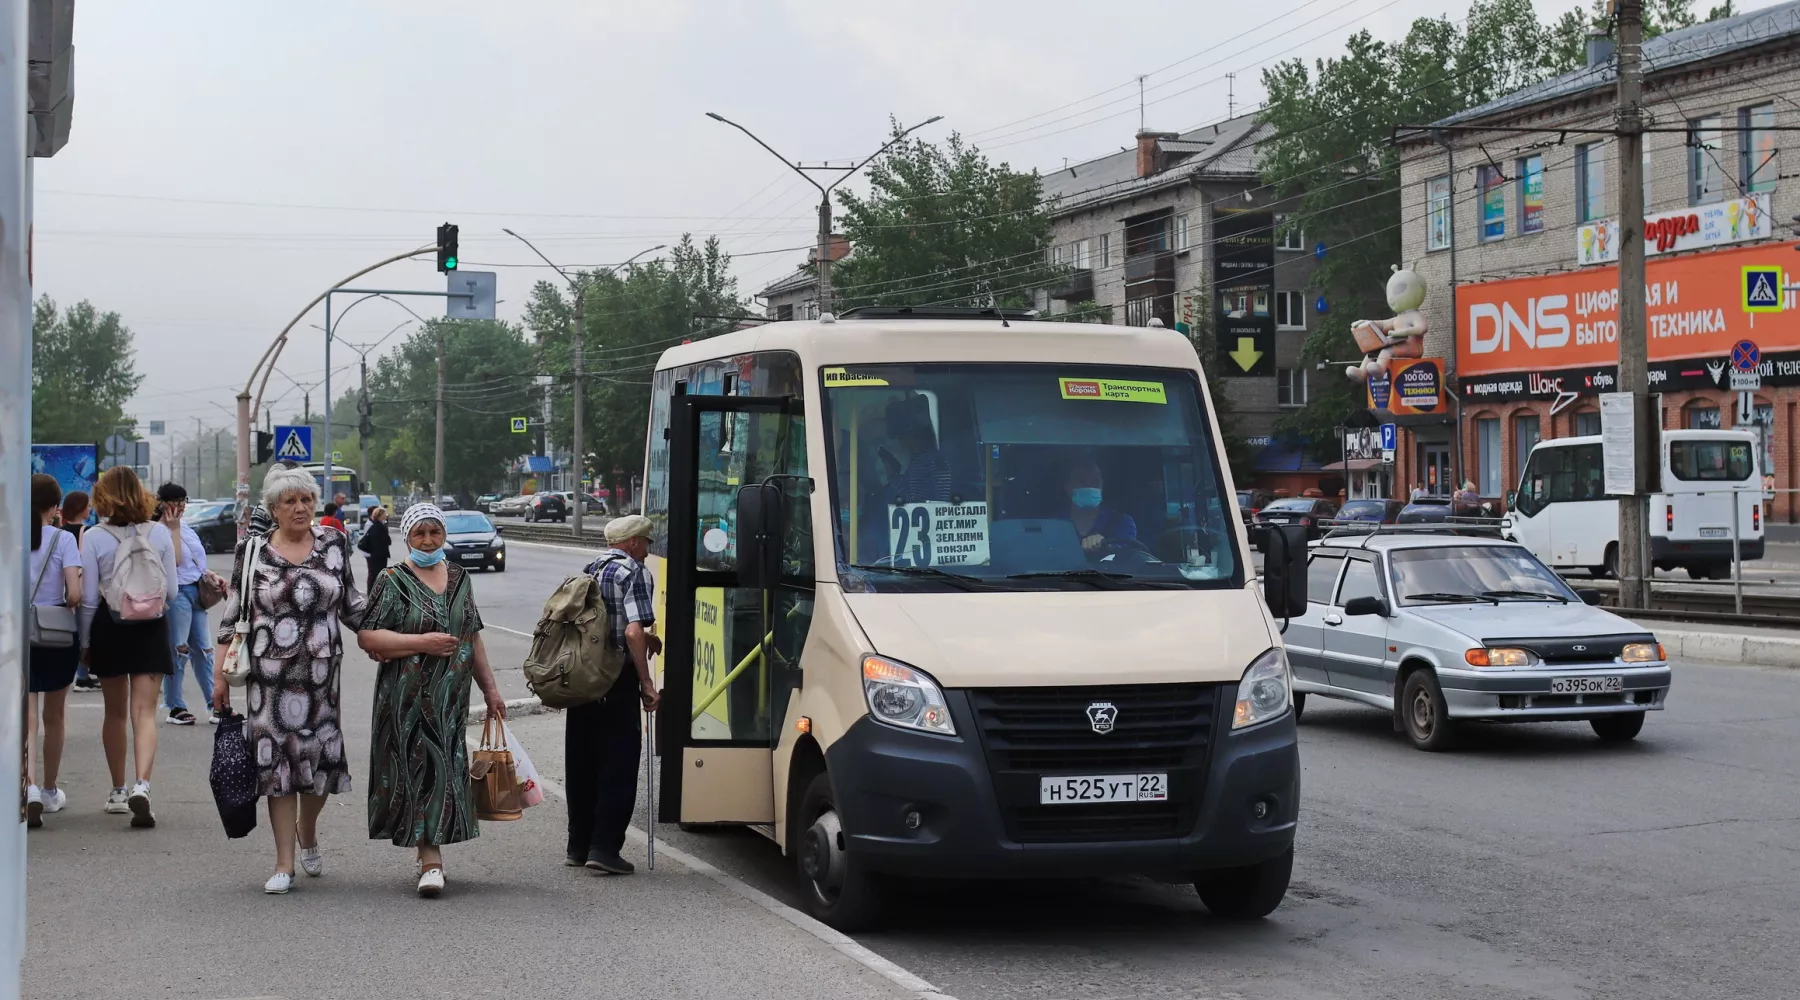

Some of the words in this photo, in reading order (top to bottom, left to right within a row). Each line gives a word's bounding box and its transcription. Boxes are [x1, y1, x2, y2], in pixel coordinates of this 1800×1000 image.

[1642, 214, 1700, 252] адуга
[1666, 280, 1678, 305] И
[1469, 294, 1571, 355] DNS
[1576, 320, 1618, 346] БЫТО
[1651, 308, 1726, 339] ТЕХНИКА
[1404, 373, 1417, 382] 100
[1418, 373, 1433, 381] 000
[1593, 372, 1613, 389] обувь
[1102, 383, 1161, 394] Транспортная
[1474, 383, 1498, 395] модная
[1498, 381, 1523, 394] одежда
[935, 505, 987, 517] КРИСТАЛЛ
[935, 519, 977, 531] ДЕТ.МИР
[891, 506, 931, 567] 23
[935, 531, 984, 543] ЗЕЛ.КЛИН
[936, 544, 976, 554] ВОКЗАЛ
[937, 554, 968, 566] ЦЕНТР
[1606, 677, 1618, 687] 22
[1140, 776, 1160, 792] 22
